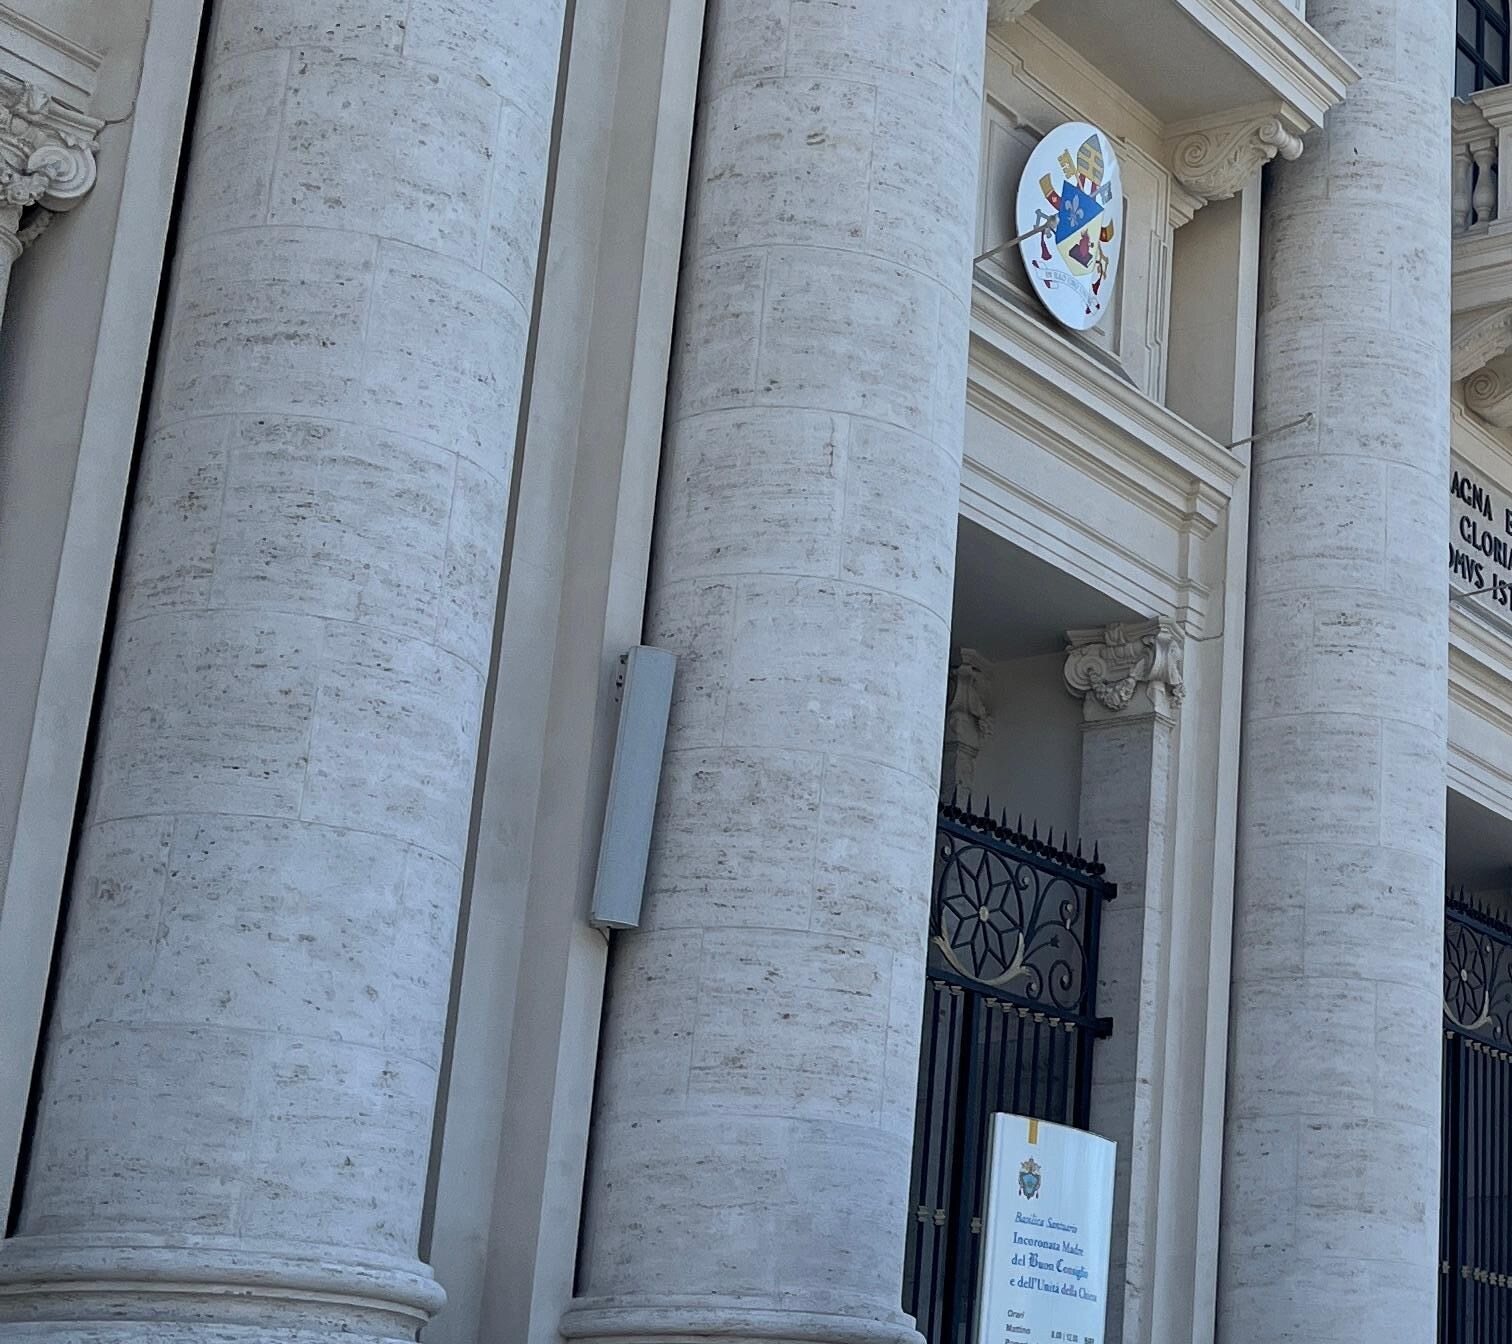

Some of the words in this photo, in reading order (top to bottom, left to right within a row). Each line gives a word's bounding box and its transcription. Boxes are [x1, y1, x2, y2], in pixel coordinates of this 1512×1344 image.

[1014, 1211, 1045, 1227] Basilica
[1013, 1231, 1060, 1251] Incoronata
[1062, 1240, 1084, 1256] Madre
[1011, 1253, 1025, 1266] del
[1028, 1252, 1054, 1271] Buon
[1061, 1283, 1077, 1298] della
[1007, 1309, 1025, 1319] Orari
[1006, 1323, 1031, 1335] Mattino
